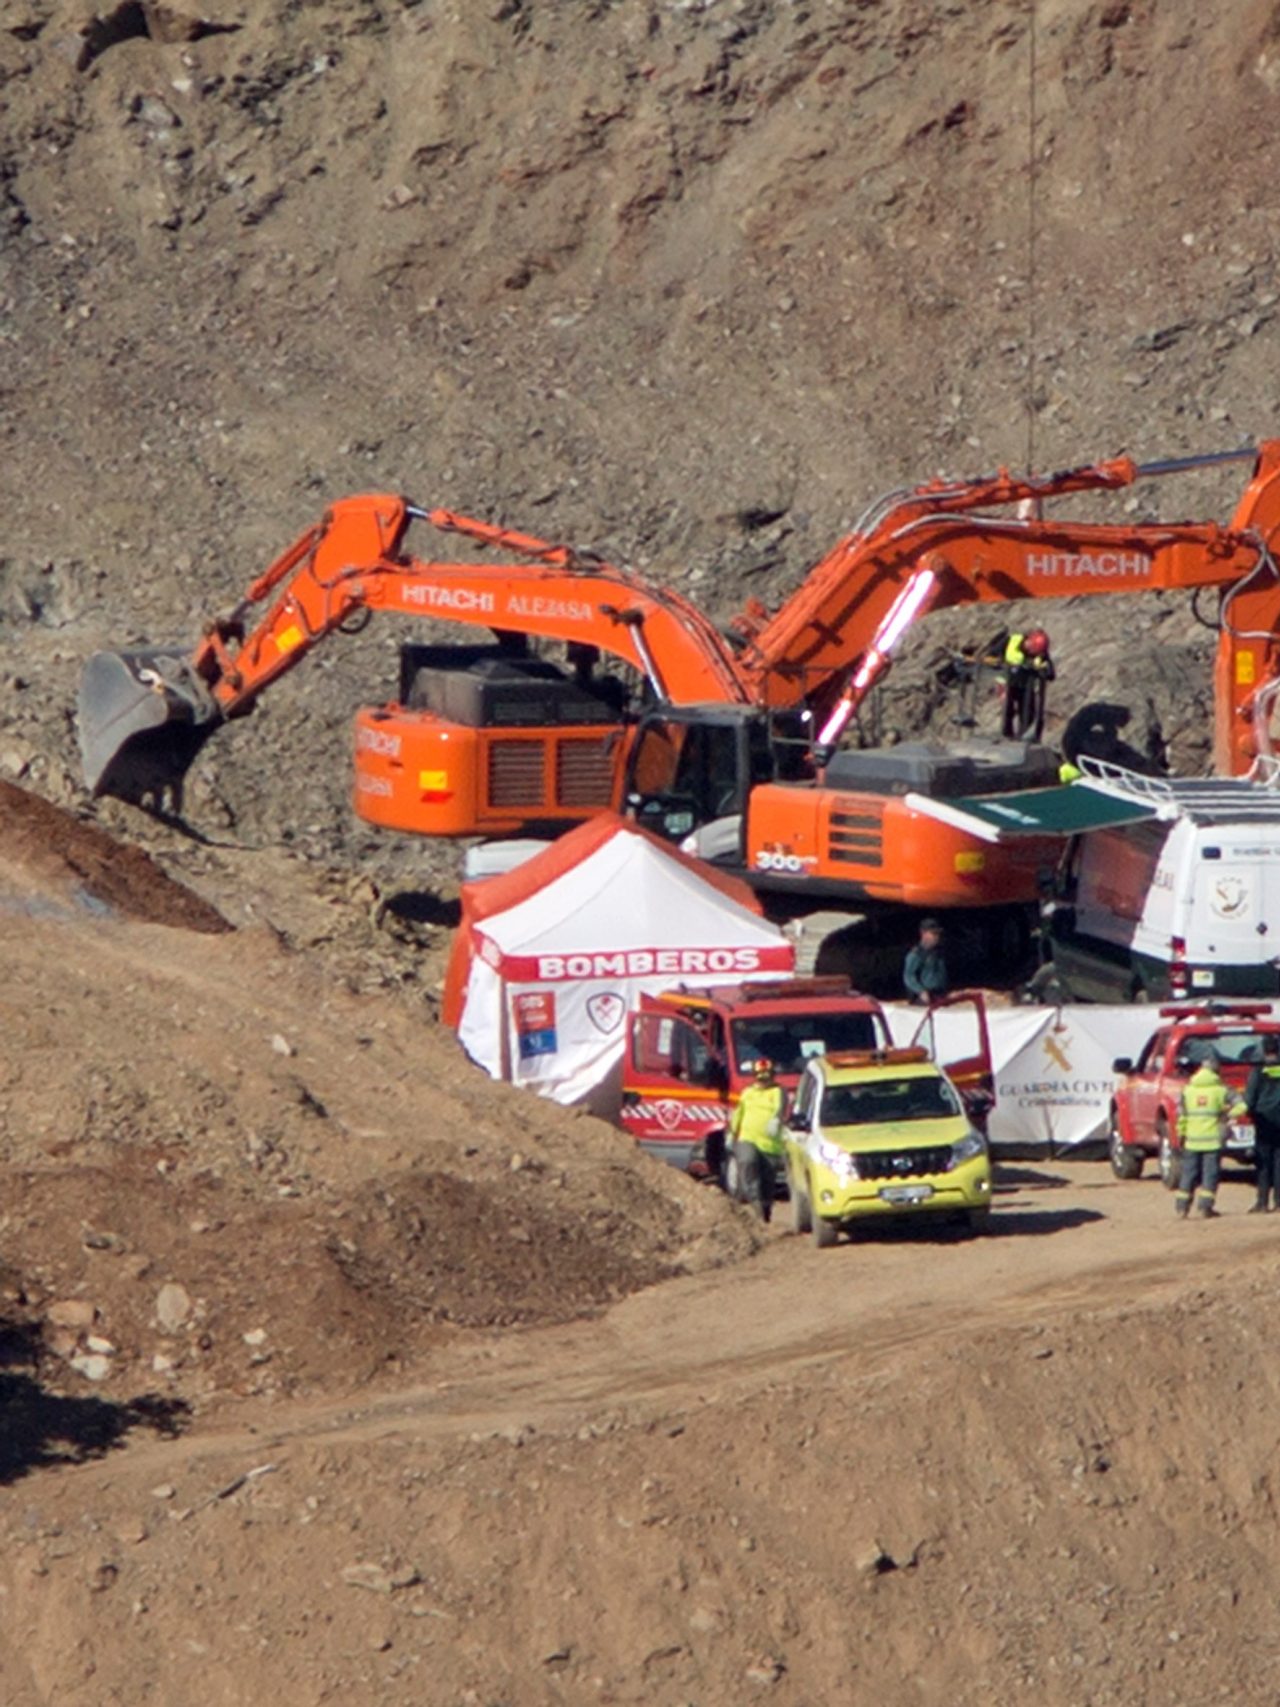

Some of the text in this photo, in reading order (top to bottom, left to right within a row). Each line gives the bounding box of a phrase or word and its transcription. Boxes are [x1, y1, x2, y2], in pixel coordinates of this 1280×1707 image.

[1027, 553, 1151, 576] HITACHI
[402, 584, 494, 612] HITACHI
[755, 851, 801, 871] 300
[538, 949, 760, 979] BOMBEROS
[999, 1078, 1115, 1097] GUARDIA CIVIL
